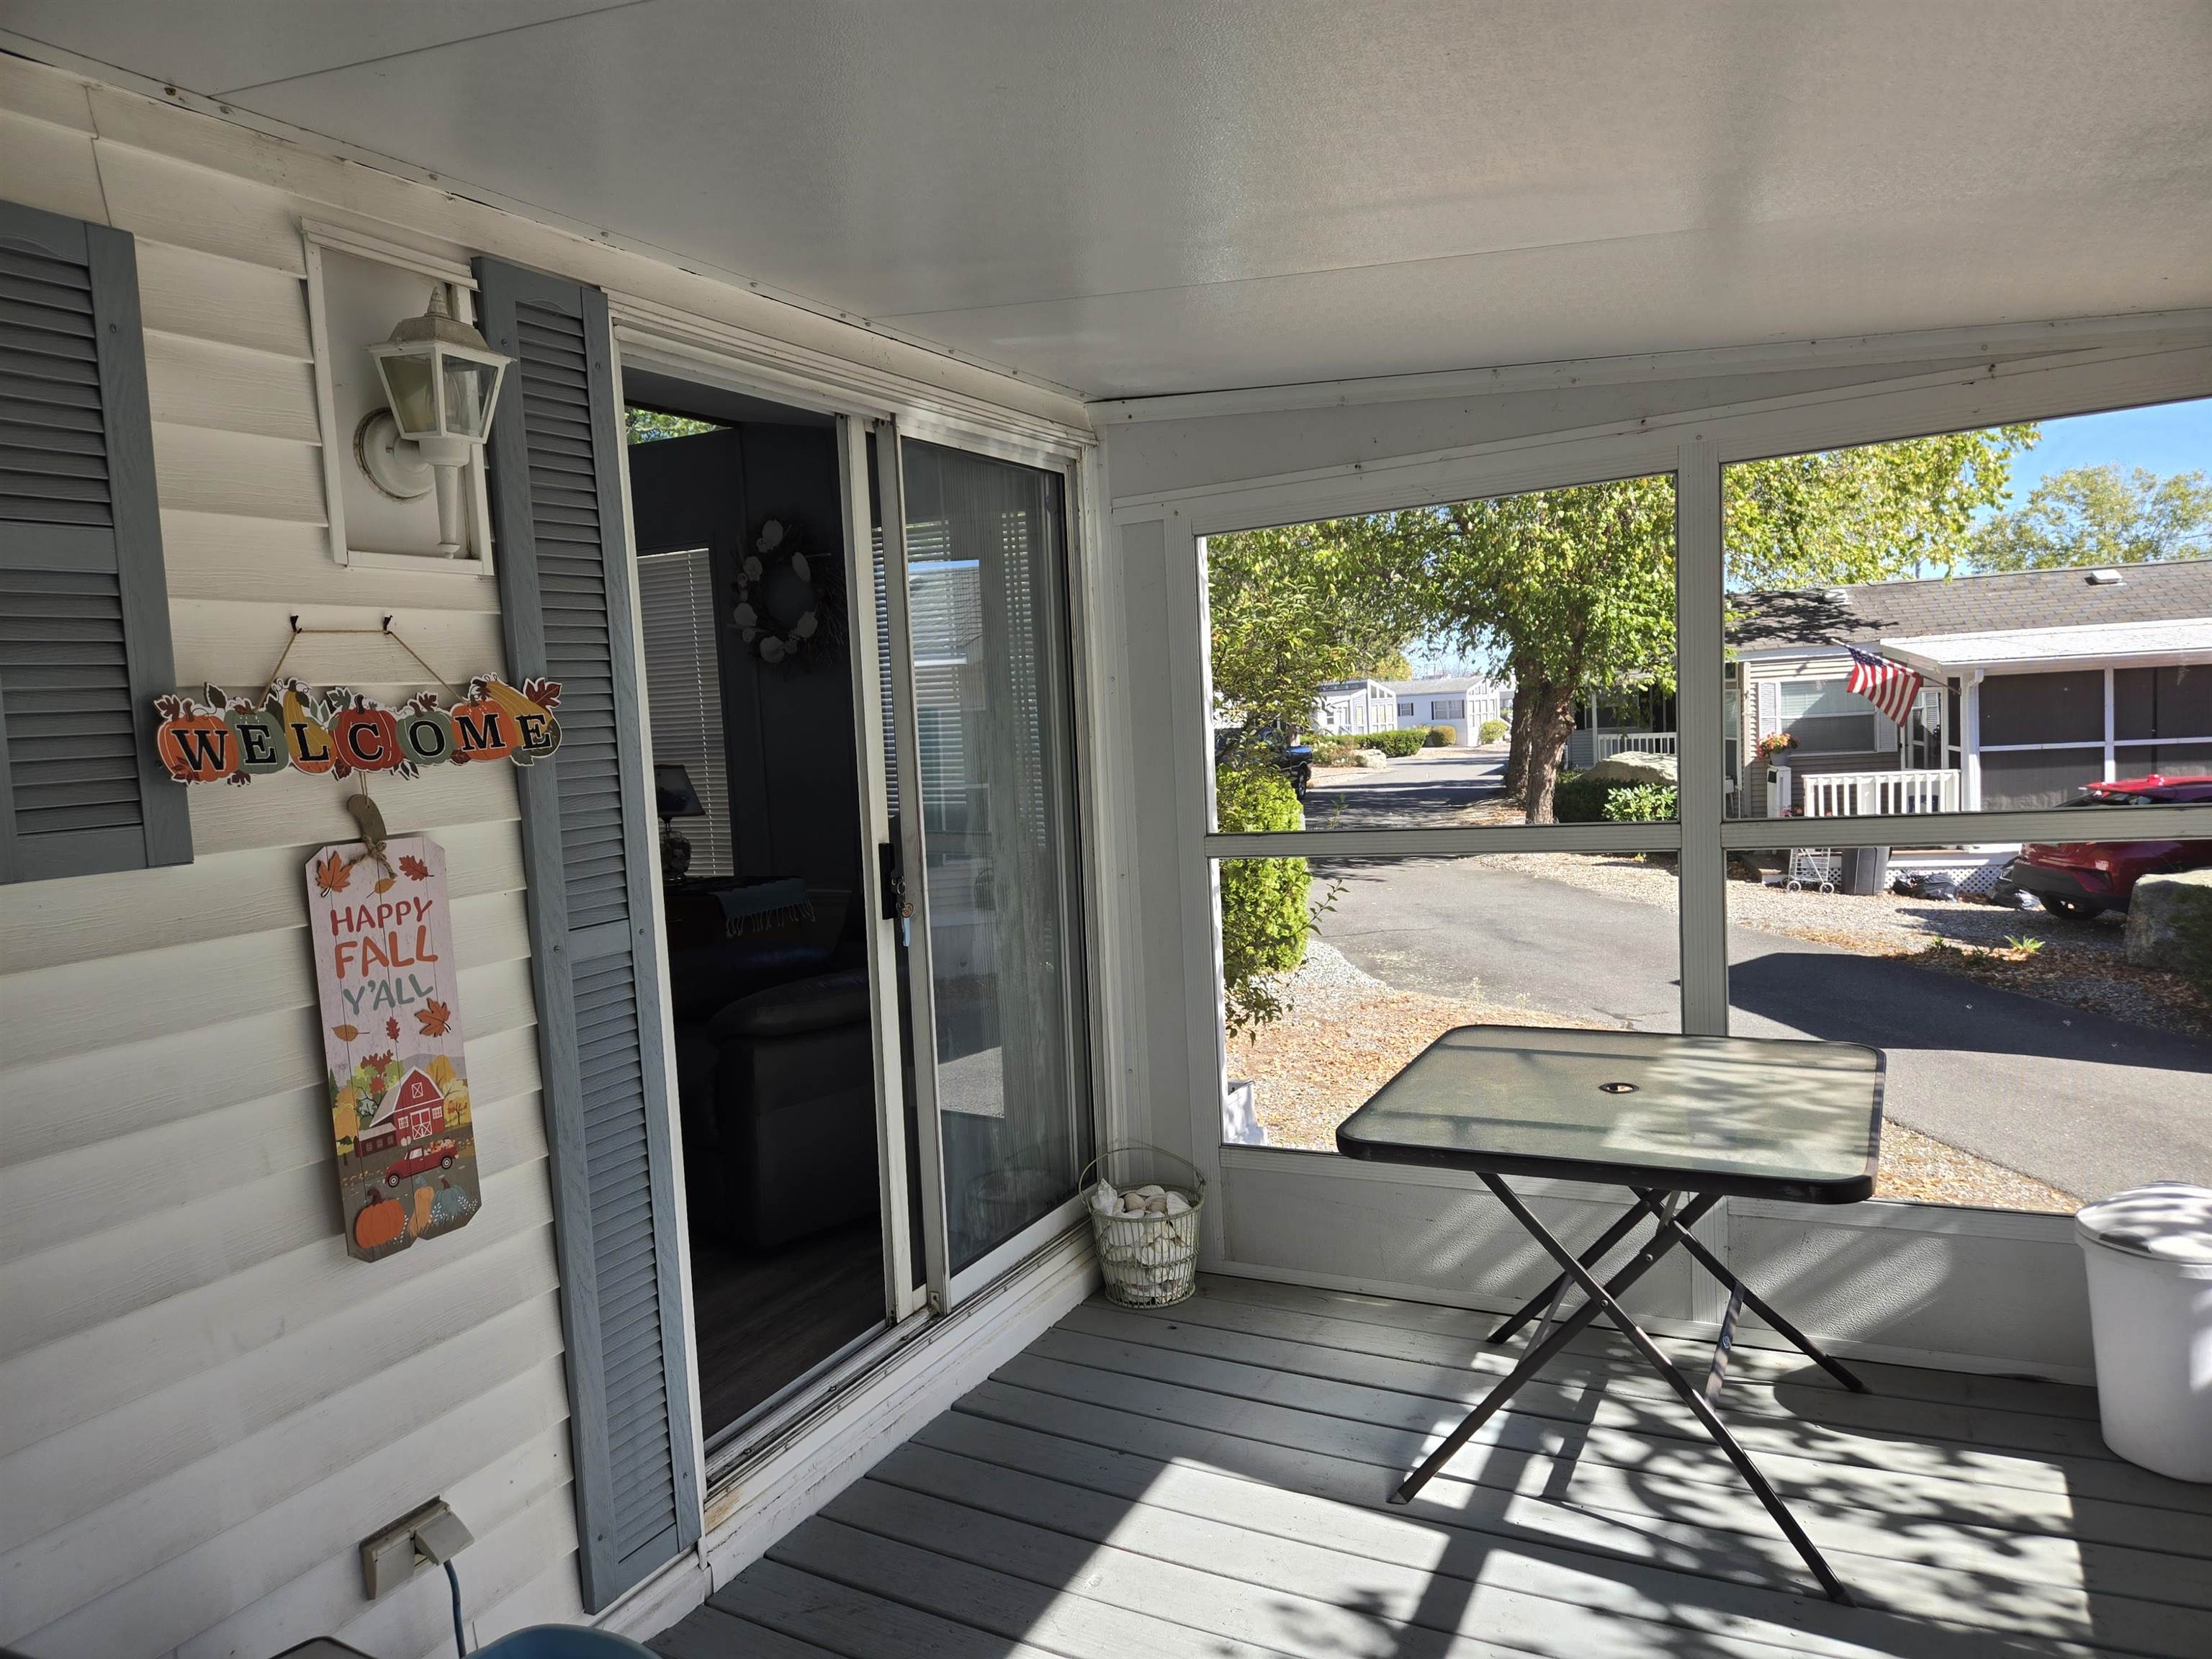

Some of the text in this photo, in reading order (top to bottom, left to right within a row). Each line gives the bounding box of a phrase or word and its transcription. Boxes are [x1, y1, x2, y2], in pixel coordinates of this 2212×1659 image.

[171, 714, 552, 772] WELCOME
[330, 896, 433, 936] HAPPY
[335, 925, 439, 979] FALL
[343, 974, 433, 1015] Y'ALL
